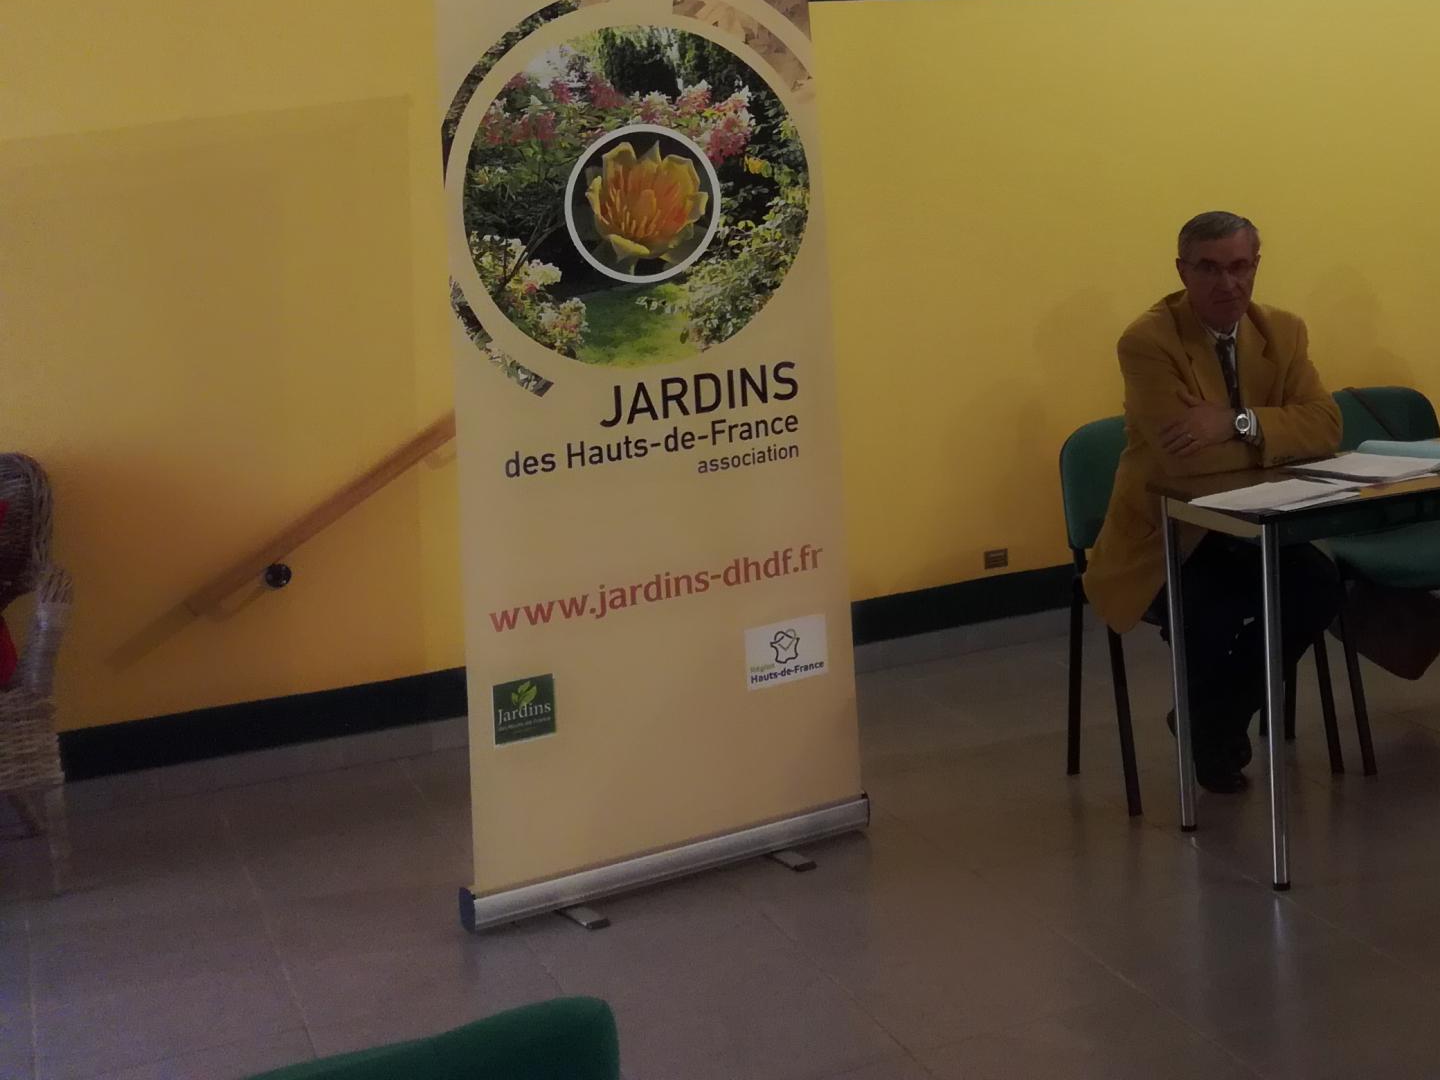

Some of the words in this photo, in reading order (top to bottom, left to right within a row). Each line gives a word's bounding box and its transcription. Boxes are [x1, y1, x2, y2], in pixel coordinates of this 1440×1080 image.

[600, 361, 799, 427] JARDINS
[505, 451, 557, 478] des
[567, 414, 799, 469] Hauts-de-France
[698, 445, 799, 474] association
[489, 544, 823, 633] www.jardins-dhdf.fr
[751, 661, 825, 684] Hauts-de-France
